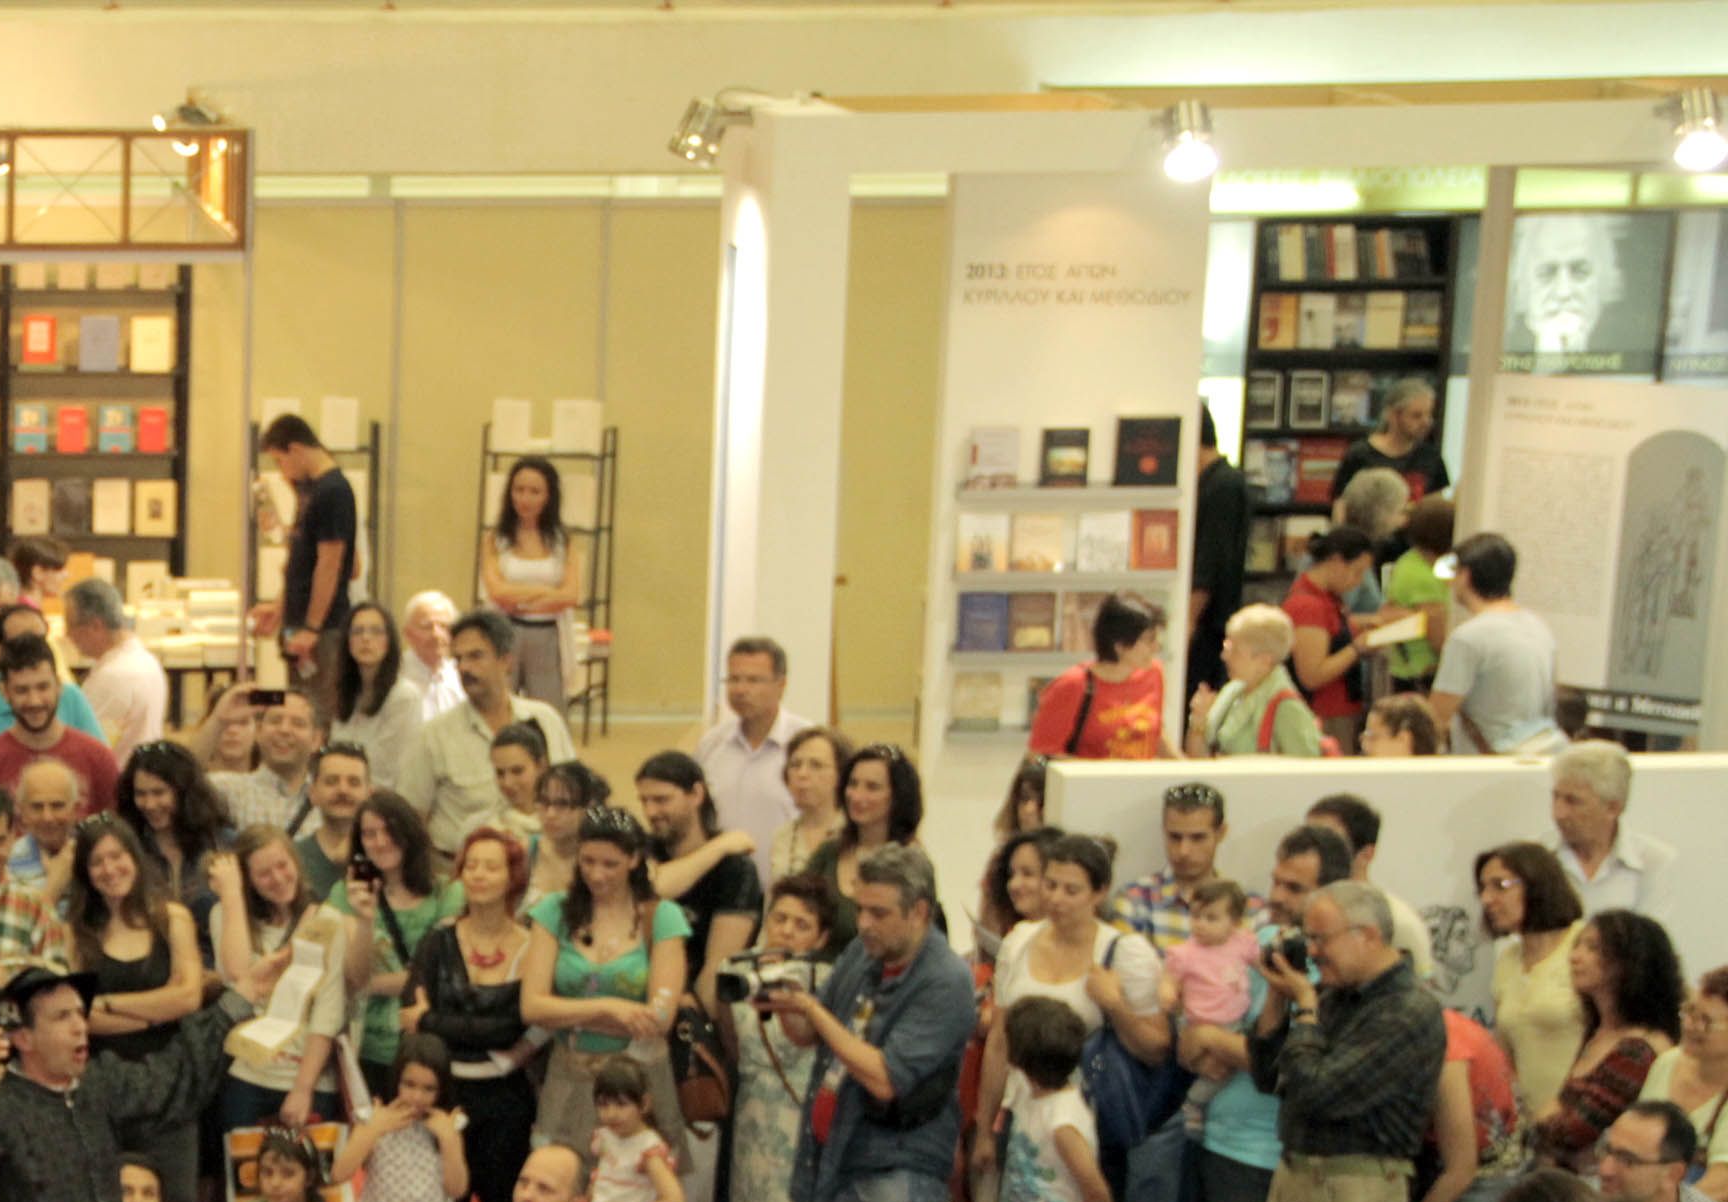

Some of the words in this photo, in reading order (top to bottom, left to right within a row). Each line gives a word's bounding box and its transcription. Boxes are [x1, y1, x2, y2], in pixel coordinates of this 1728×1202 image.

[1015, 263, 1056, 280] ΕΤΟΣ
[962, 287, 1049, 306] ΚΥΡΙΛΛΟΥ
[1055, 287, 1083, 304] ΚΑΙ
[1089, 287, 1191, 306] ΜΕΘΟΔΙΟΥ
